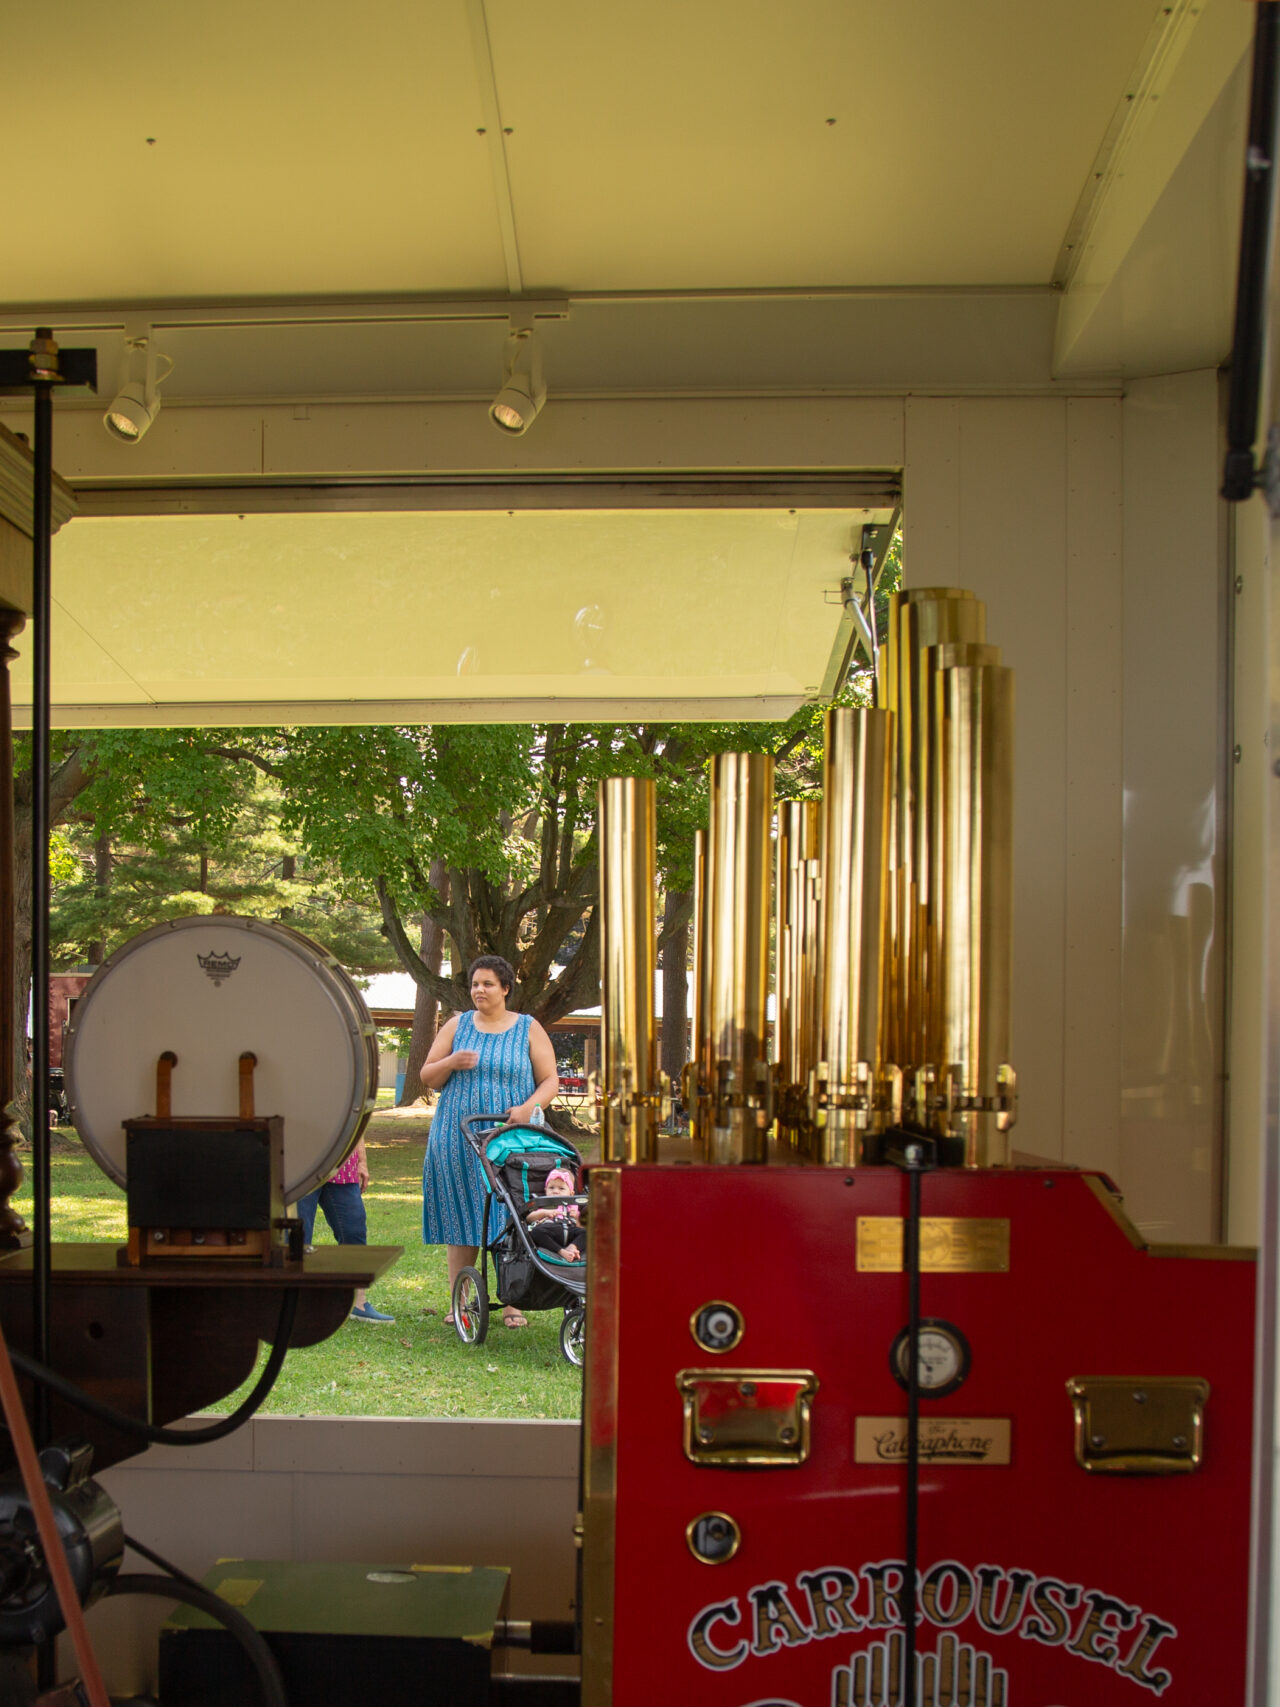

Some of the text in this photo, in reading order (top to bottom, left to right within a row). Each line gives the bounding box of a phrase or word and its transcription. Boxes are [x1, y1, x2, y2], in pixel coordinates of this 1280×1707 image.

[203, 960, 238, 970] REMO
[873, 1430, 993, 1460] Caliaphone
[688, 1560, 1177, 1696] CARROUSEL
